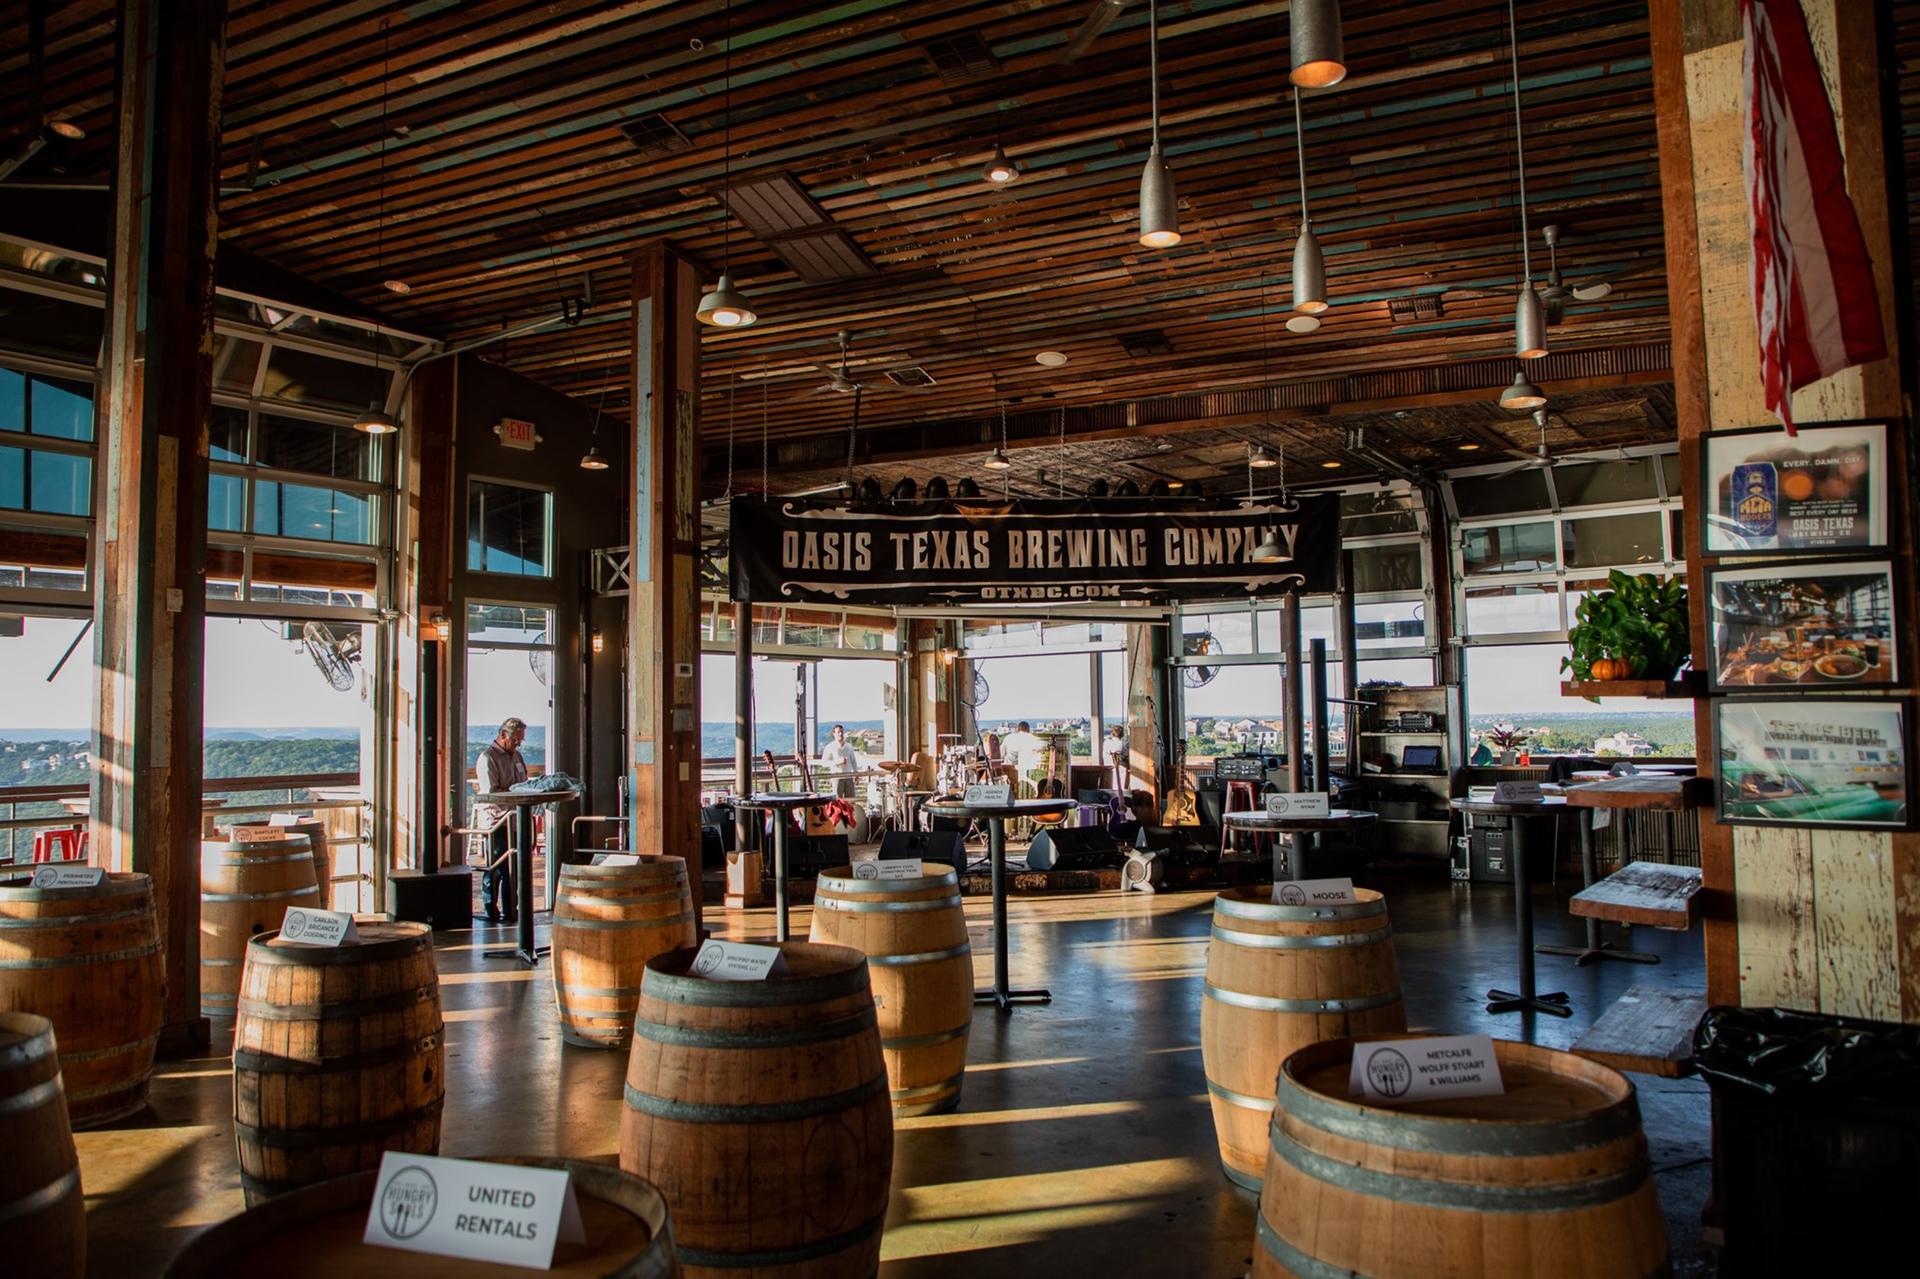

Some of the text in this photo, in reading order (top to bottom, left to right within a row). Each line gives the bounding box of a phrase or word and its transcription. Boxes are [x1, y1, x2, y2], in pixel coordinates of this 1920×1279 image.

[510, 420, 531, 441] EXIT
[1793, 516, 1854, 531] OASIS TEXAS
[782, 530, 872, 571] OASIS
[890, 530, 990, 571] TEXAS
[1008, 528, 1147, 569] BREWING
[981, 584, 1121, 599] OTXBC.COM
[1840, 726, 1879, 739] BEER
[1312, 891, 1347, 900] MOOSE
[313, 916, 338, 924] CARLSON
[1427, 1048, 1472, 1060] METCALFE
[1371, 1062, 1405, 1074] HUNGRY
[1417, 1060, 1485, 1074] WOLFF STUART
[1429, 1074, 1481, 1086] & WILLIAMS
[387, 1186, 434, 1205] HUNGRY
[468, 1185, 537, 1210] UNITED
[455, 1213, 538, 1241] RENTALS
